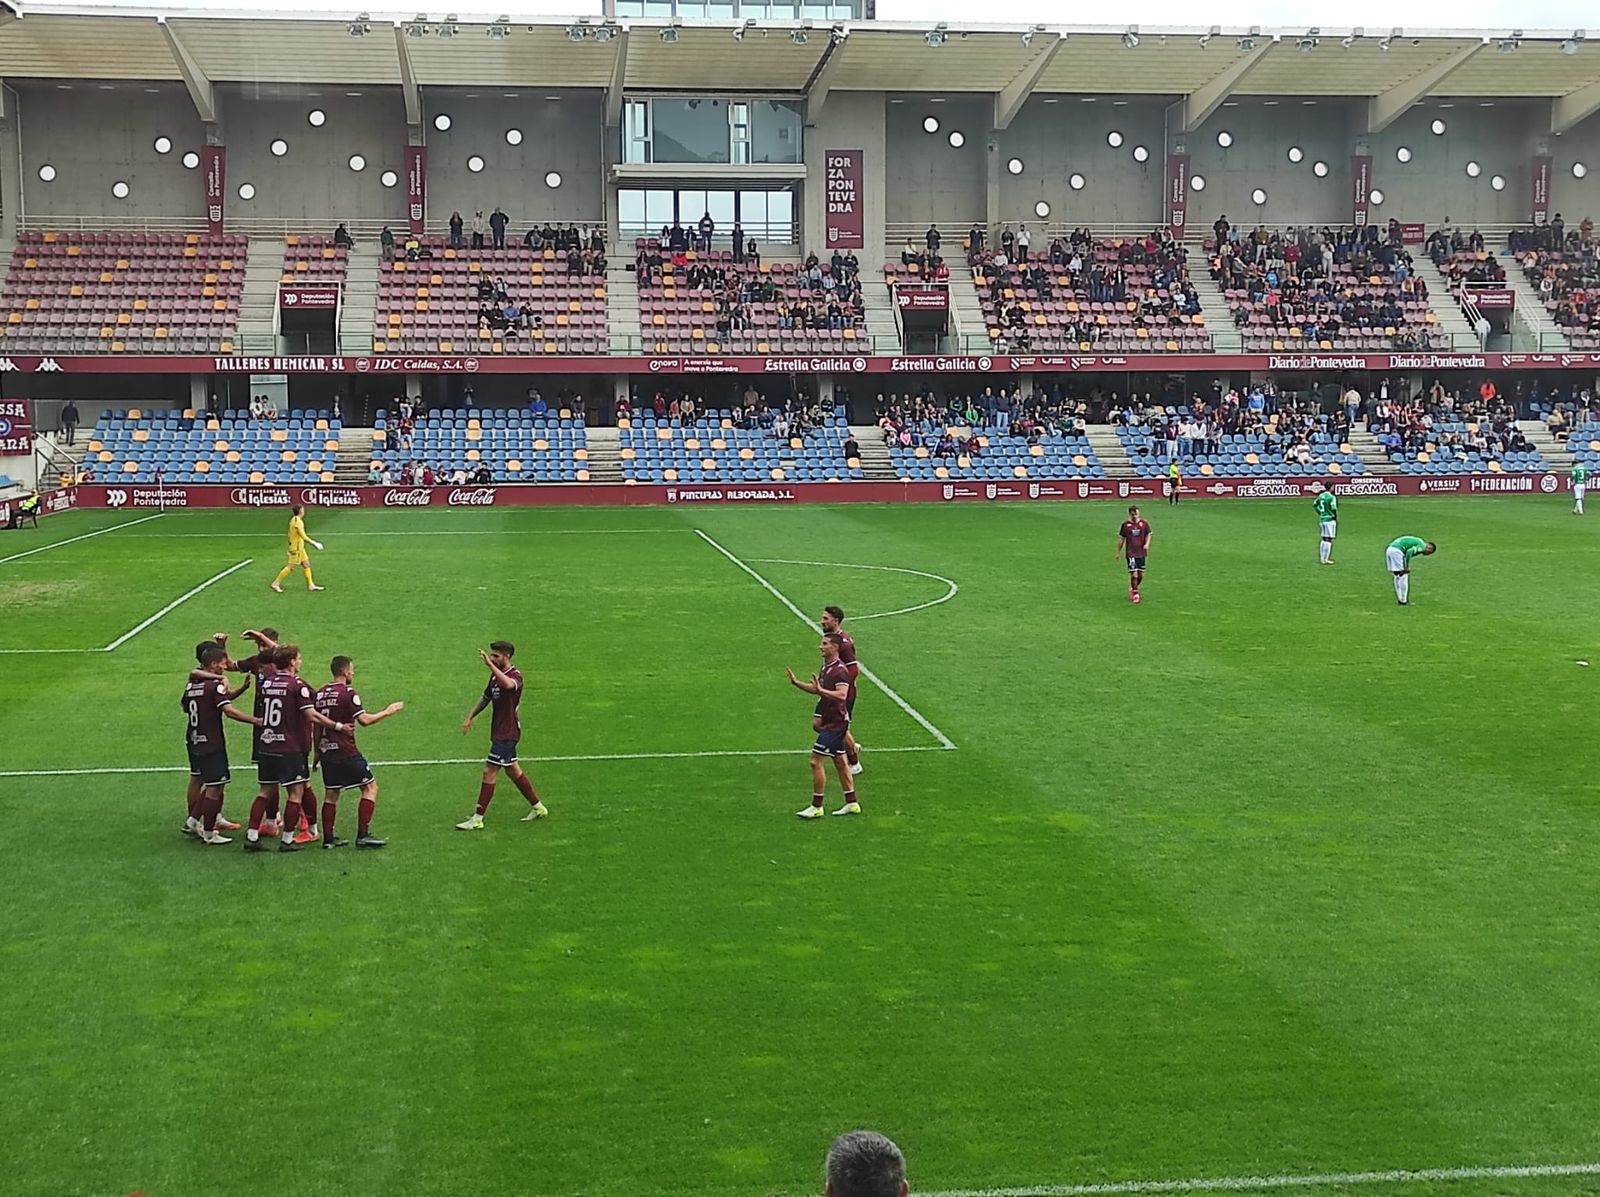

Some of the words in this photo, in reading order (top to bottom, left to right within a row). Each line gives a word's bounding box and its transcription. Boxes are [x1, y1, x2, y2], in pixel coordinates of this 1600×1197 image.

[828, 157, 852, 168] FOR
[828, 169, 844, 179] ZA
[828, 180, 854, 190] PON
[828, 191, 856, 201] TEVE
[828, 203, 853, 213] DRA
[215, 358, 270, 370] TALLERES
[332, 358, 345, 370] SL
[373, 359, 401, 370] IDC
[404, 359, 440, 370] Caldas,
[442, 360, 463, 369] S.A.
[765, 358, 808, 371] Estrella
[810, 358, 850, 371] Galicia
[891, 358, 934, 371] Estrella
[936, 358, 976, 371] Galicia
[1269, 356, 1300, 369] Diario
[1310, 356, 1366, 369] Pontevedra
[1390, 356, 1420, 368] Diario
[1430, 356, 1485, 368] Pontevedra
[1481, 477, 1533, 490] FEDERACIÓN
[133, 489, 187, 498] Deputación
[680, 490, 723, 500] PINTURAS
[1237, 485, 1301, 496] PESCAMAR
[1335, 484, 1398, 495] PESCAMAR
[133, 498, 187, 506] Pontevedra
[189, 700, 198, 727] 8
[263, 698, 282, 727] 16
